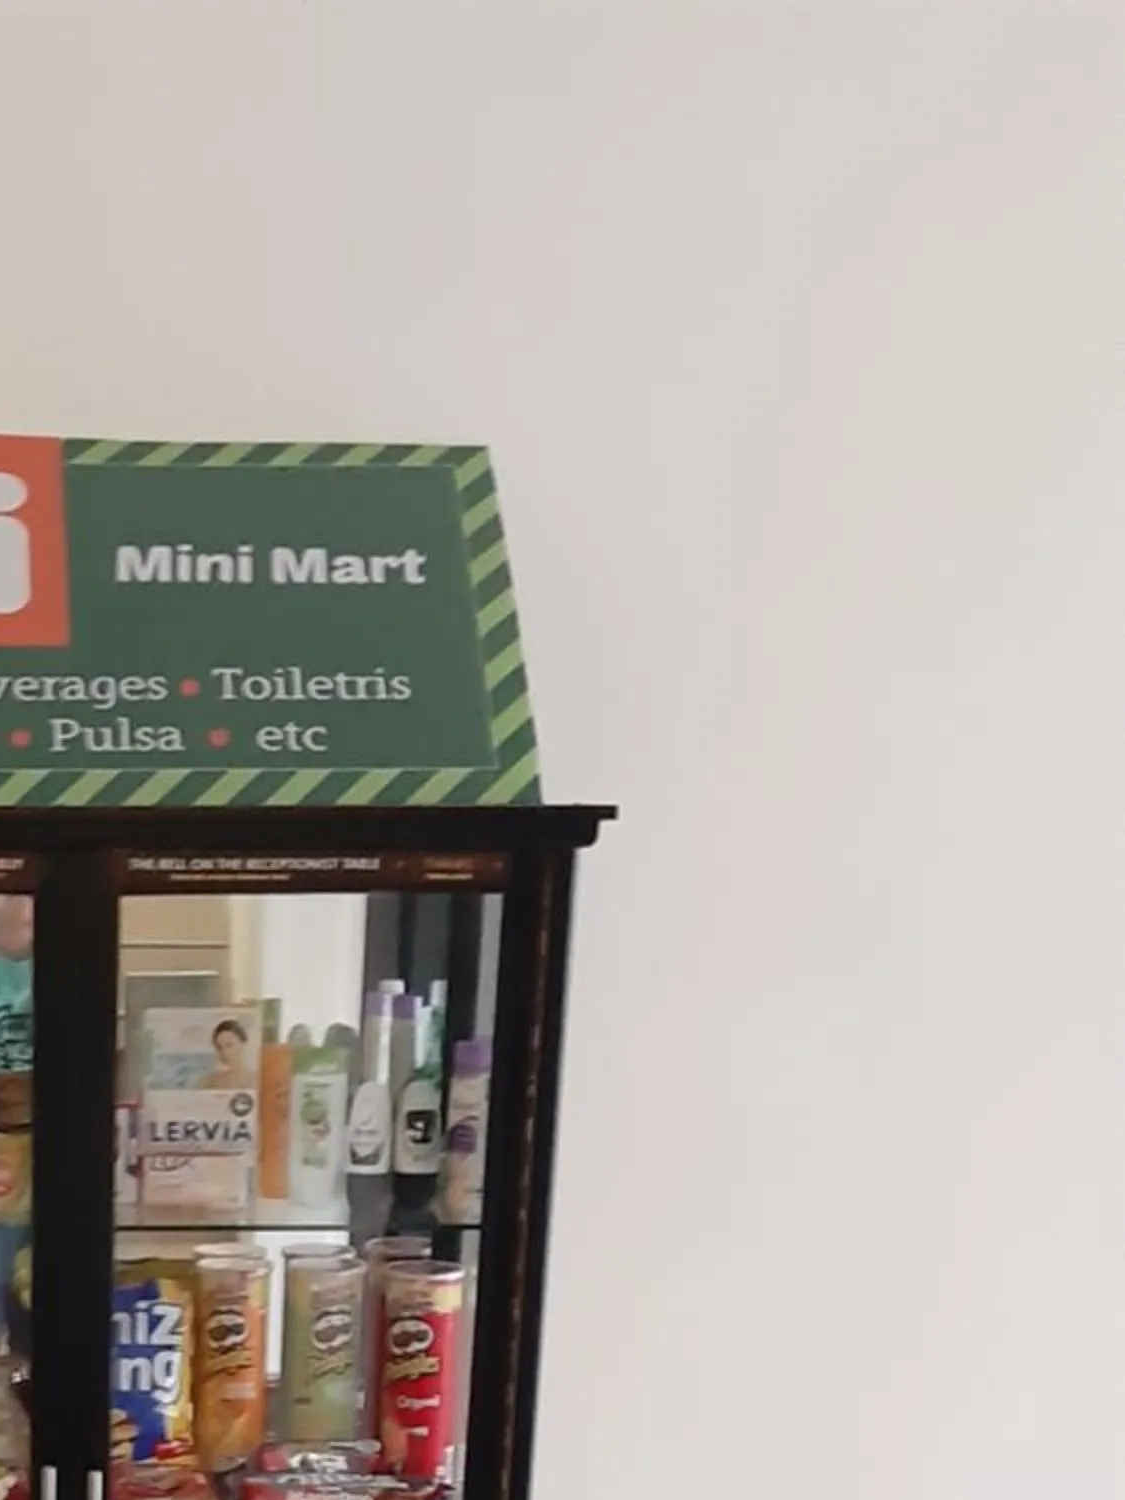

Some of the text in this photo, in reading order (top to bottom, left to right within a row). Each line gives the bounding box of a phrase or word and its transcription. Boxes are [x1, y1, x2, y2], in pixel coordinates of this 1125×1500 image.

[114, 543, 428, 586] Mini Mart
[209, 665, 413, 703] Toiletris
[48, 716, 187, 753] Pulsa
[254, 721, 330, 754] etc
